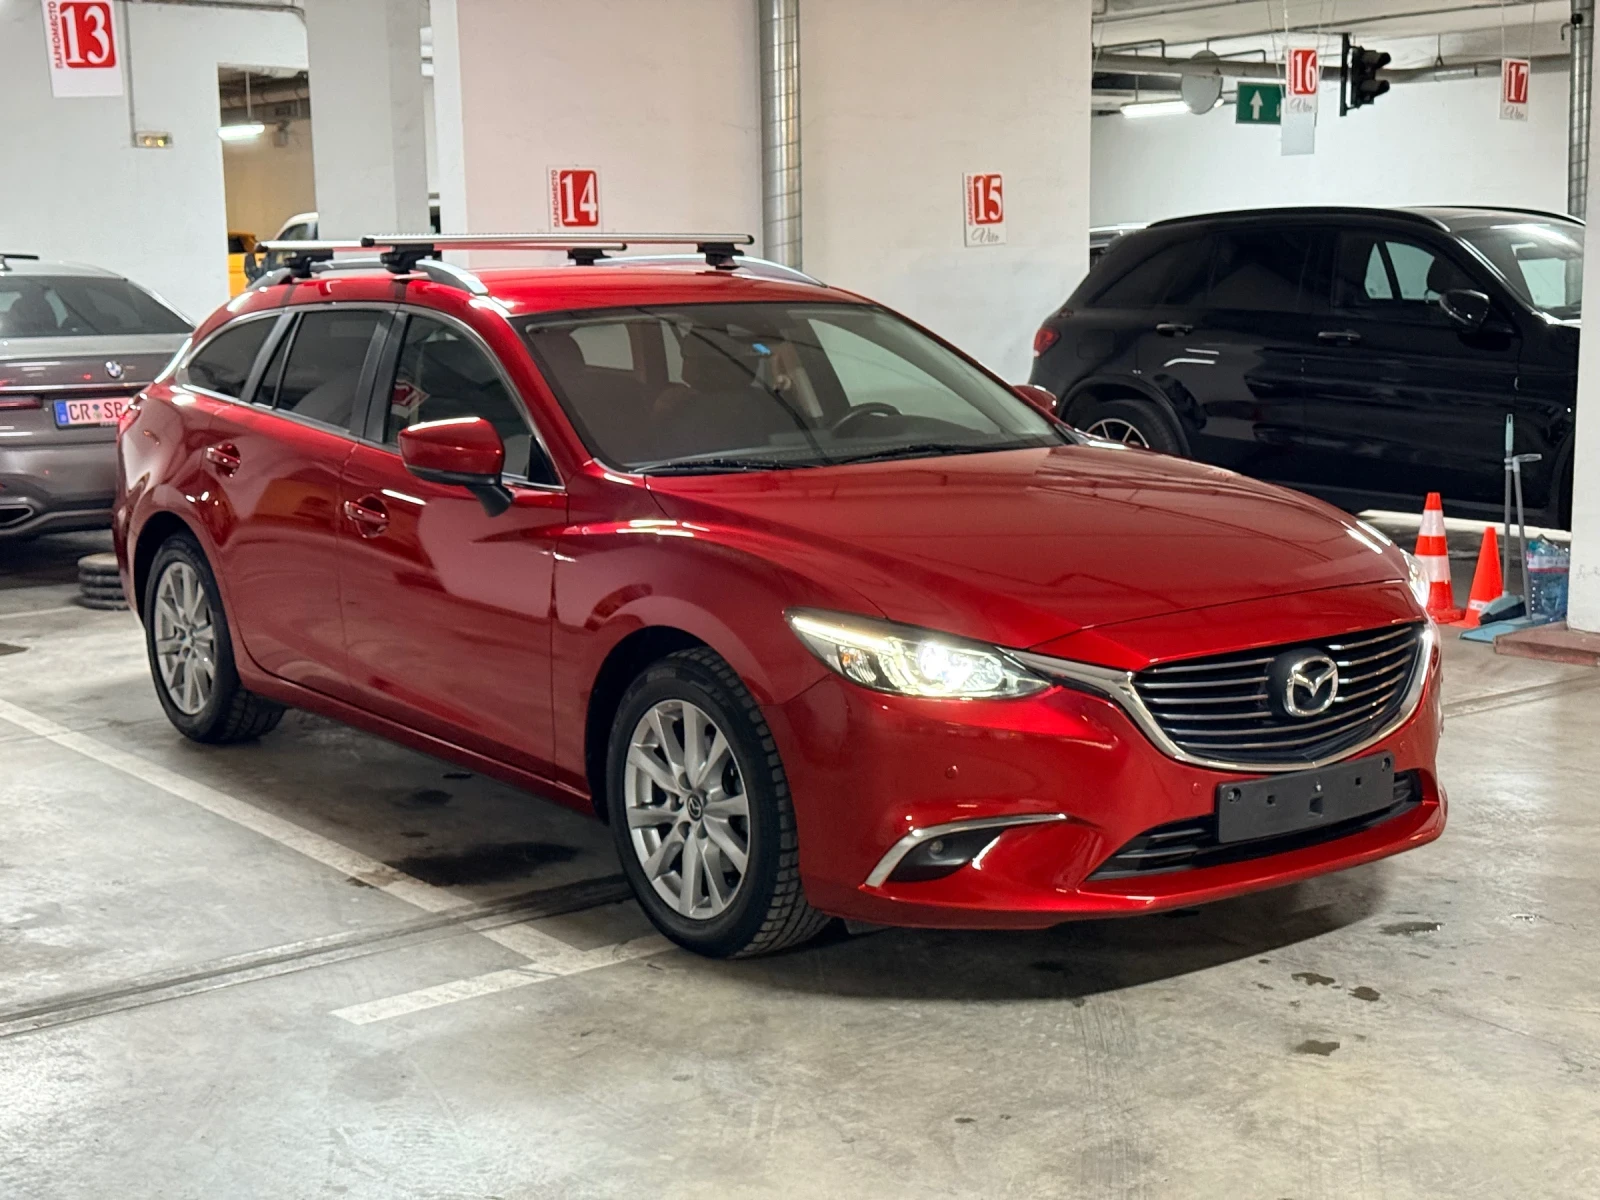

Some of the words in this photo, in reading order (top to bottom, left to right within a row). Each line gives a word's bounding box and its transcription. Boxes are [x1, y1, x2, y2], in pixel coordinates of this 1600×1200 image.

[60, 5, 111, 64] 13
[1295, 51, 1317, 93] 16
[1508, 63, 1529, 102] 17
[561, 172, 598, 223] 14
[975, 177, 1002, 221] 15
[69, 403, 91, 421] CR
